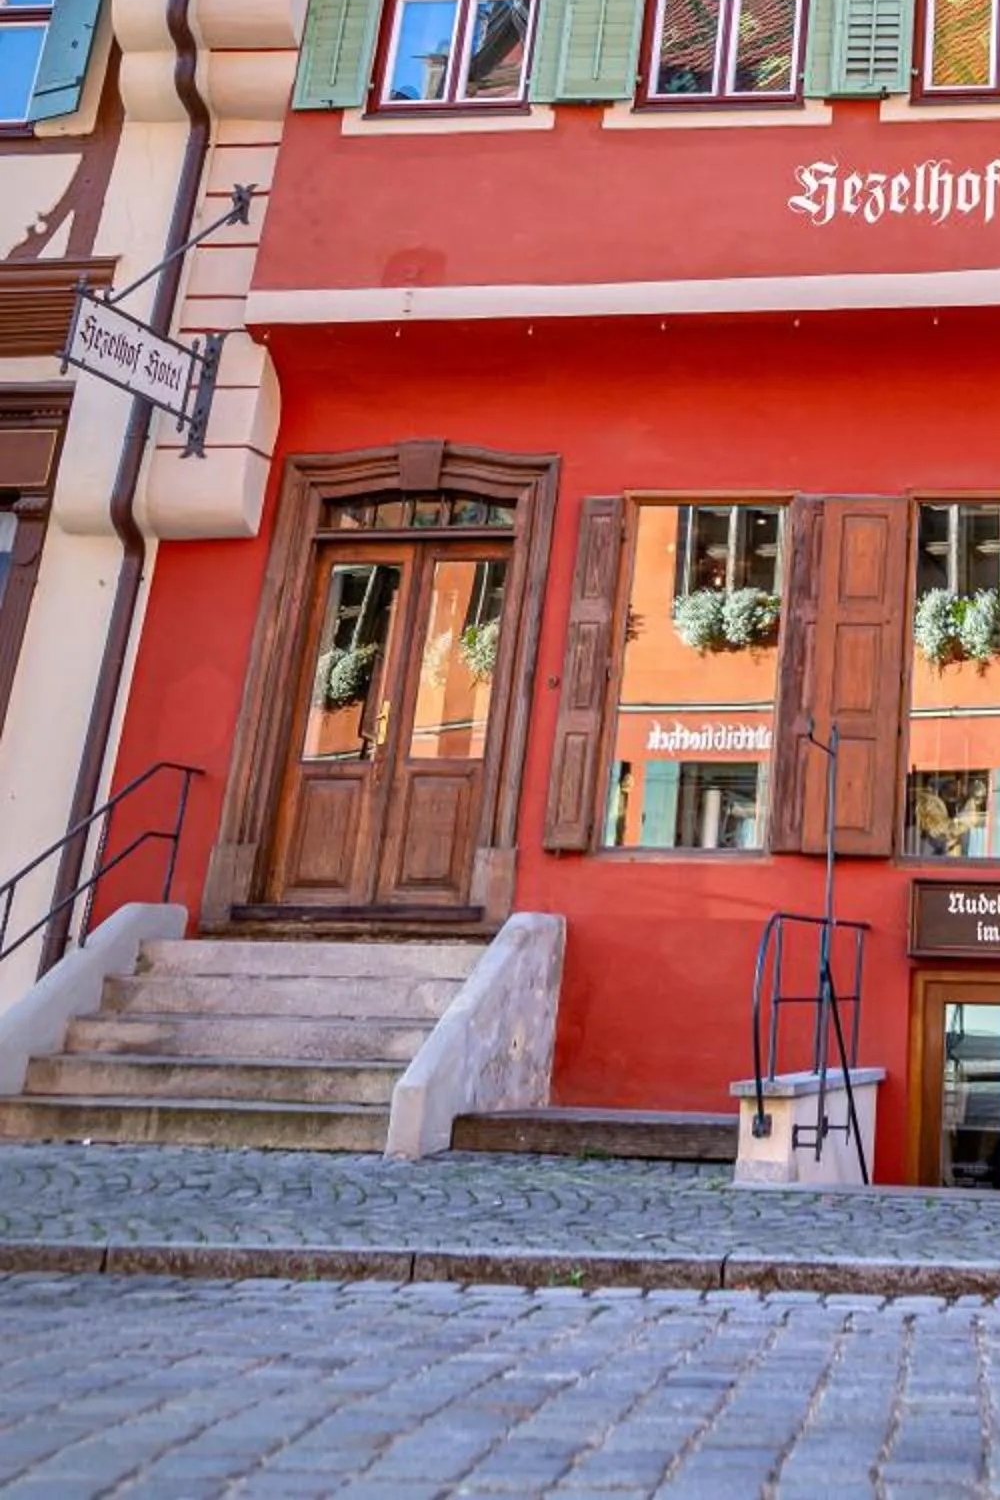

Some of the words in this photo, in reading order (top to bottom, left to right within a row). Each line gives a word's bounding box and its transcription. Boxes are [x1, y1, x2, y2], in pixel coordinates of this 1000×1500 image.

[80, 315, 143, 374] Hezelhof
[144, 349, 183, 391] Hotel
[976, 921, 1000, 942] im
